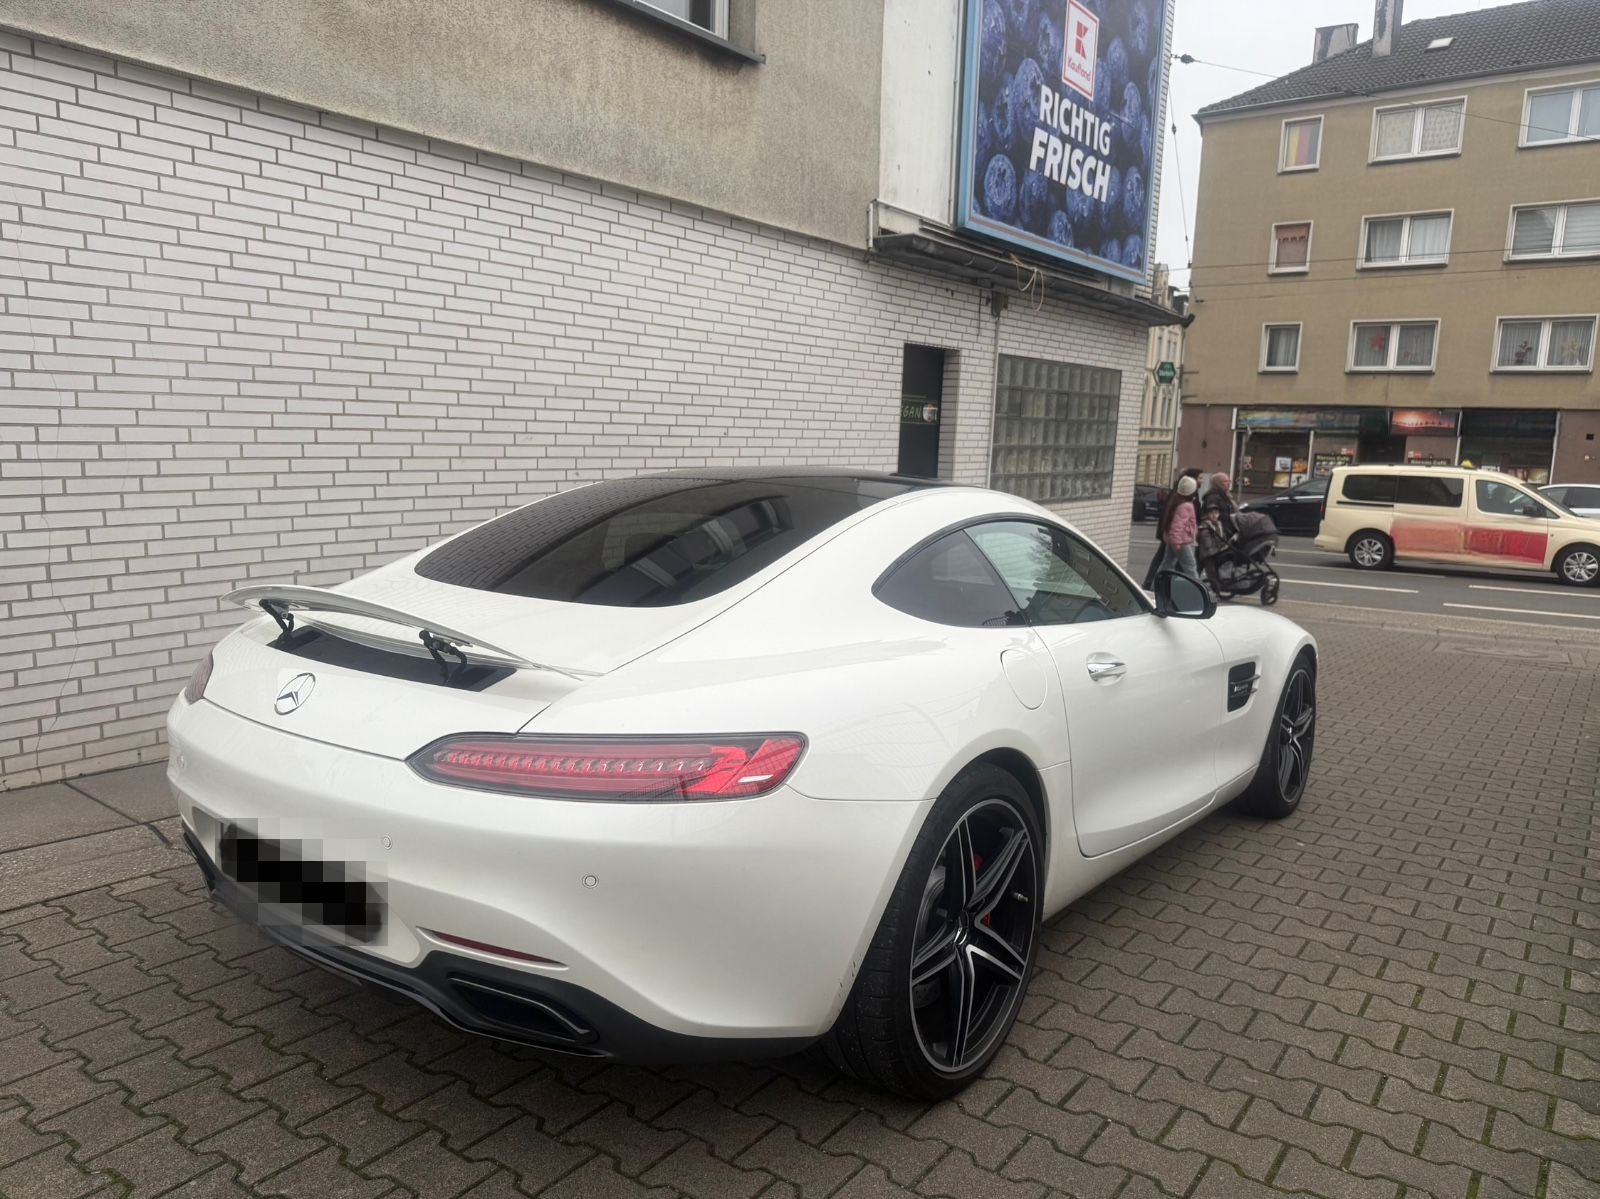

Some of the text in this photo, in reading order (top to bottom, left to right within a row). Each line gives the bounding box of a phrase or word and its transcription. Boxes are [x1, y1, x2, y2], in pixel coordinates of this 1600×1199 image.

[1067, 55, 1092, 82] Kaufland
[1039, 84, 1111, 156] RICHTIG
[1029, 127, 1111, 203] FRISCH
